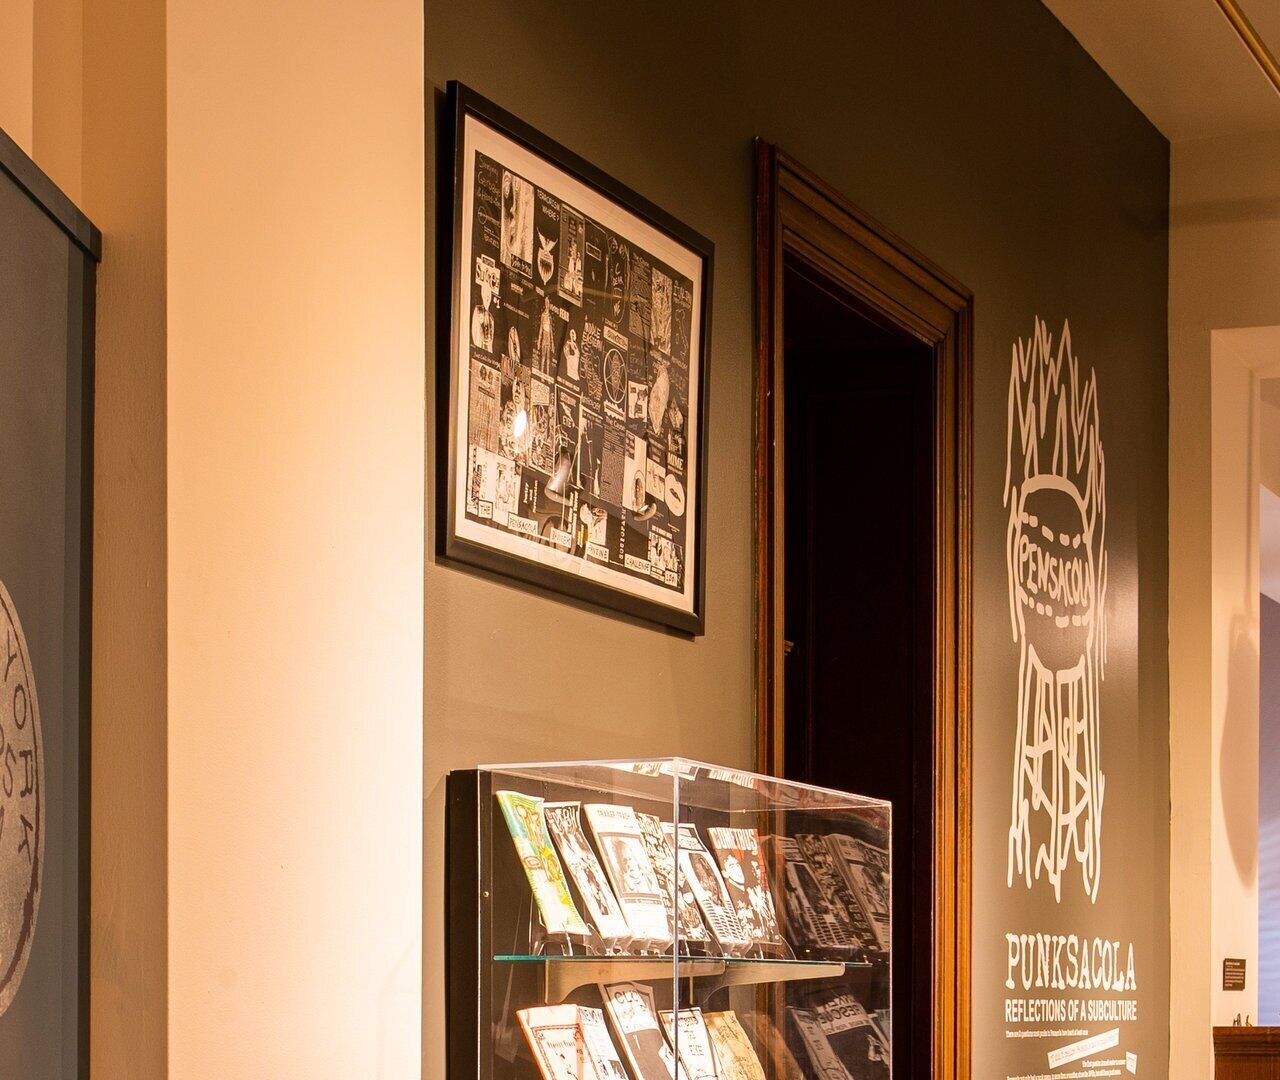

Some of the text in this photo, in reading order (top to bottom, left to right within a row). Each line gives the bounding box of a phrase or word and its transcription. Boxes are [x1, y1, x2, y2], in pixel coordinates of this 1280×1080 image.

[4, 628, 32, 866] YORK
[1005, 932, 1137, 992] PUNKSACOLA
[1005, 999, 1137, 1023] REFLECTIONS OF A SUBCULTURE
